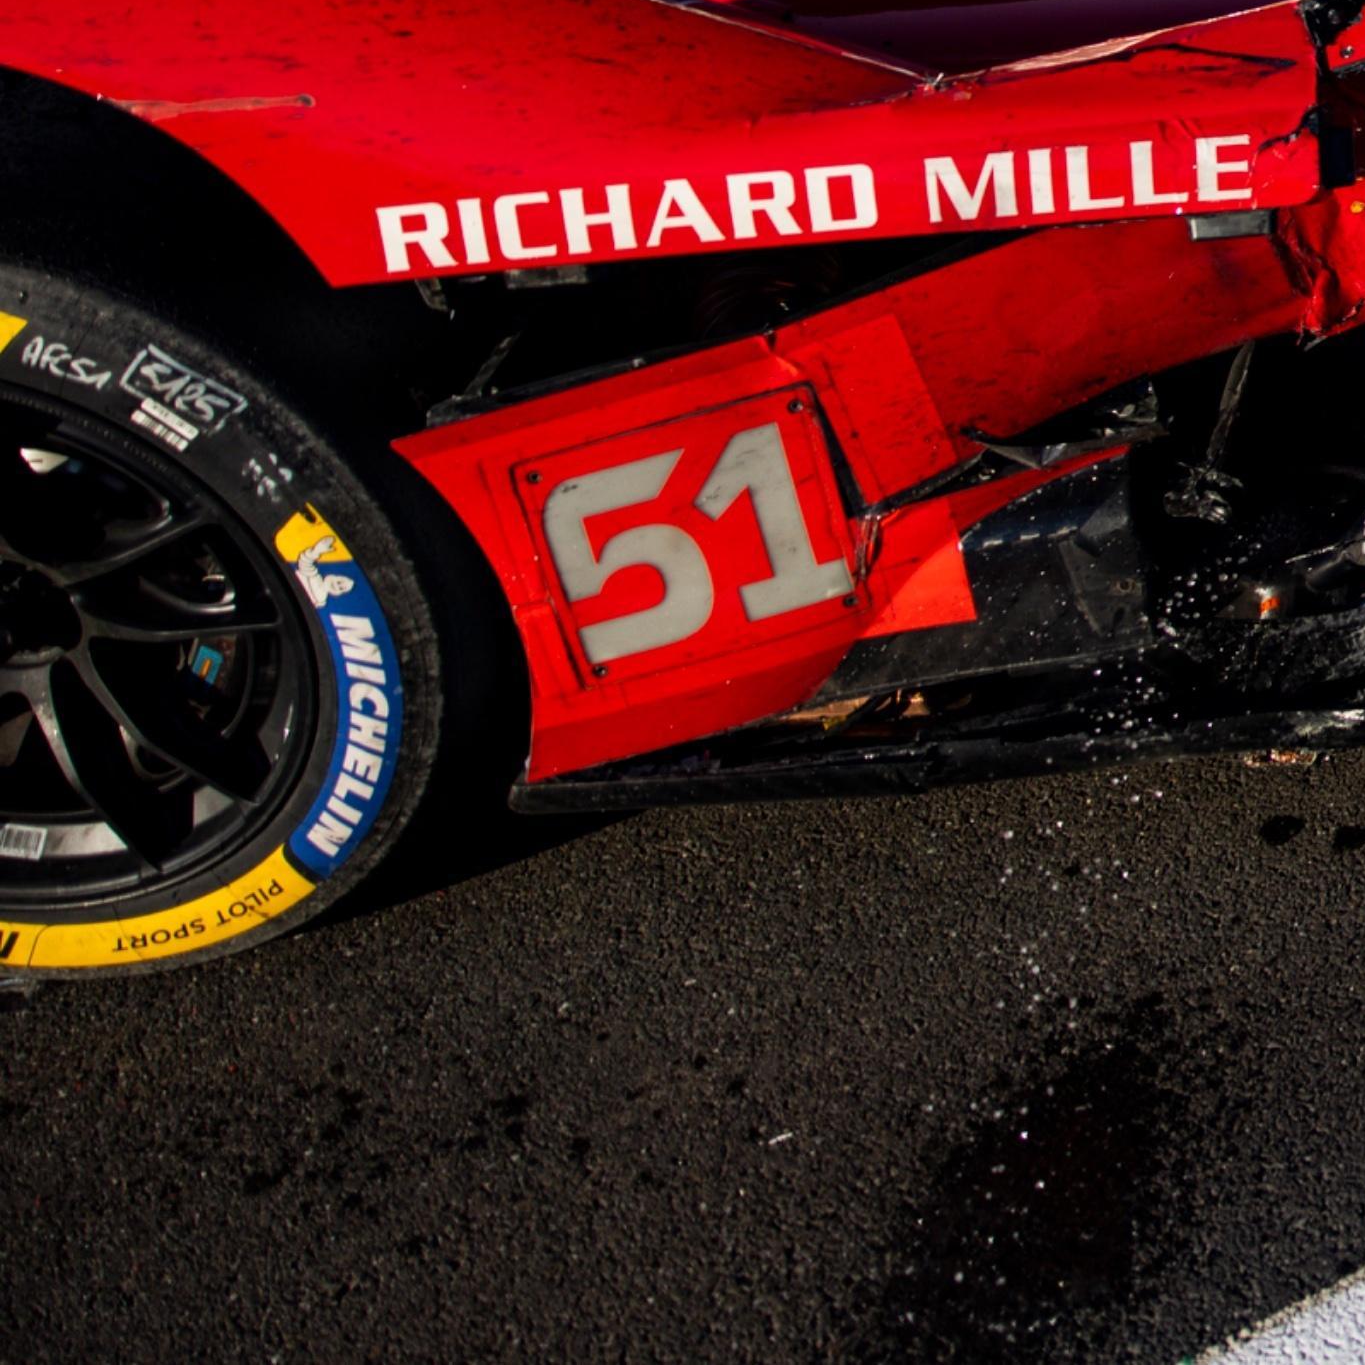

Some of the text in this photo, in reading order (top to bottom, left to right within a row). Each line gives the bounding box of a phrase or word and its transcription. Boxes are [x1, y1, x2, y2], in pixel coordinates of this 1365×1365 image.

[376, 133, 1254, 275] RICHARD MILLE
[541, 420, 854, 662] 51
[307, 613, 392, 858] MICHELIN
[112, 878, 285, 952] PILOT SPORT
